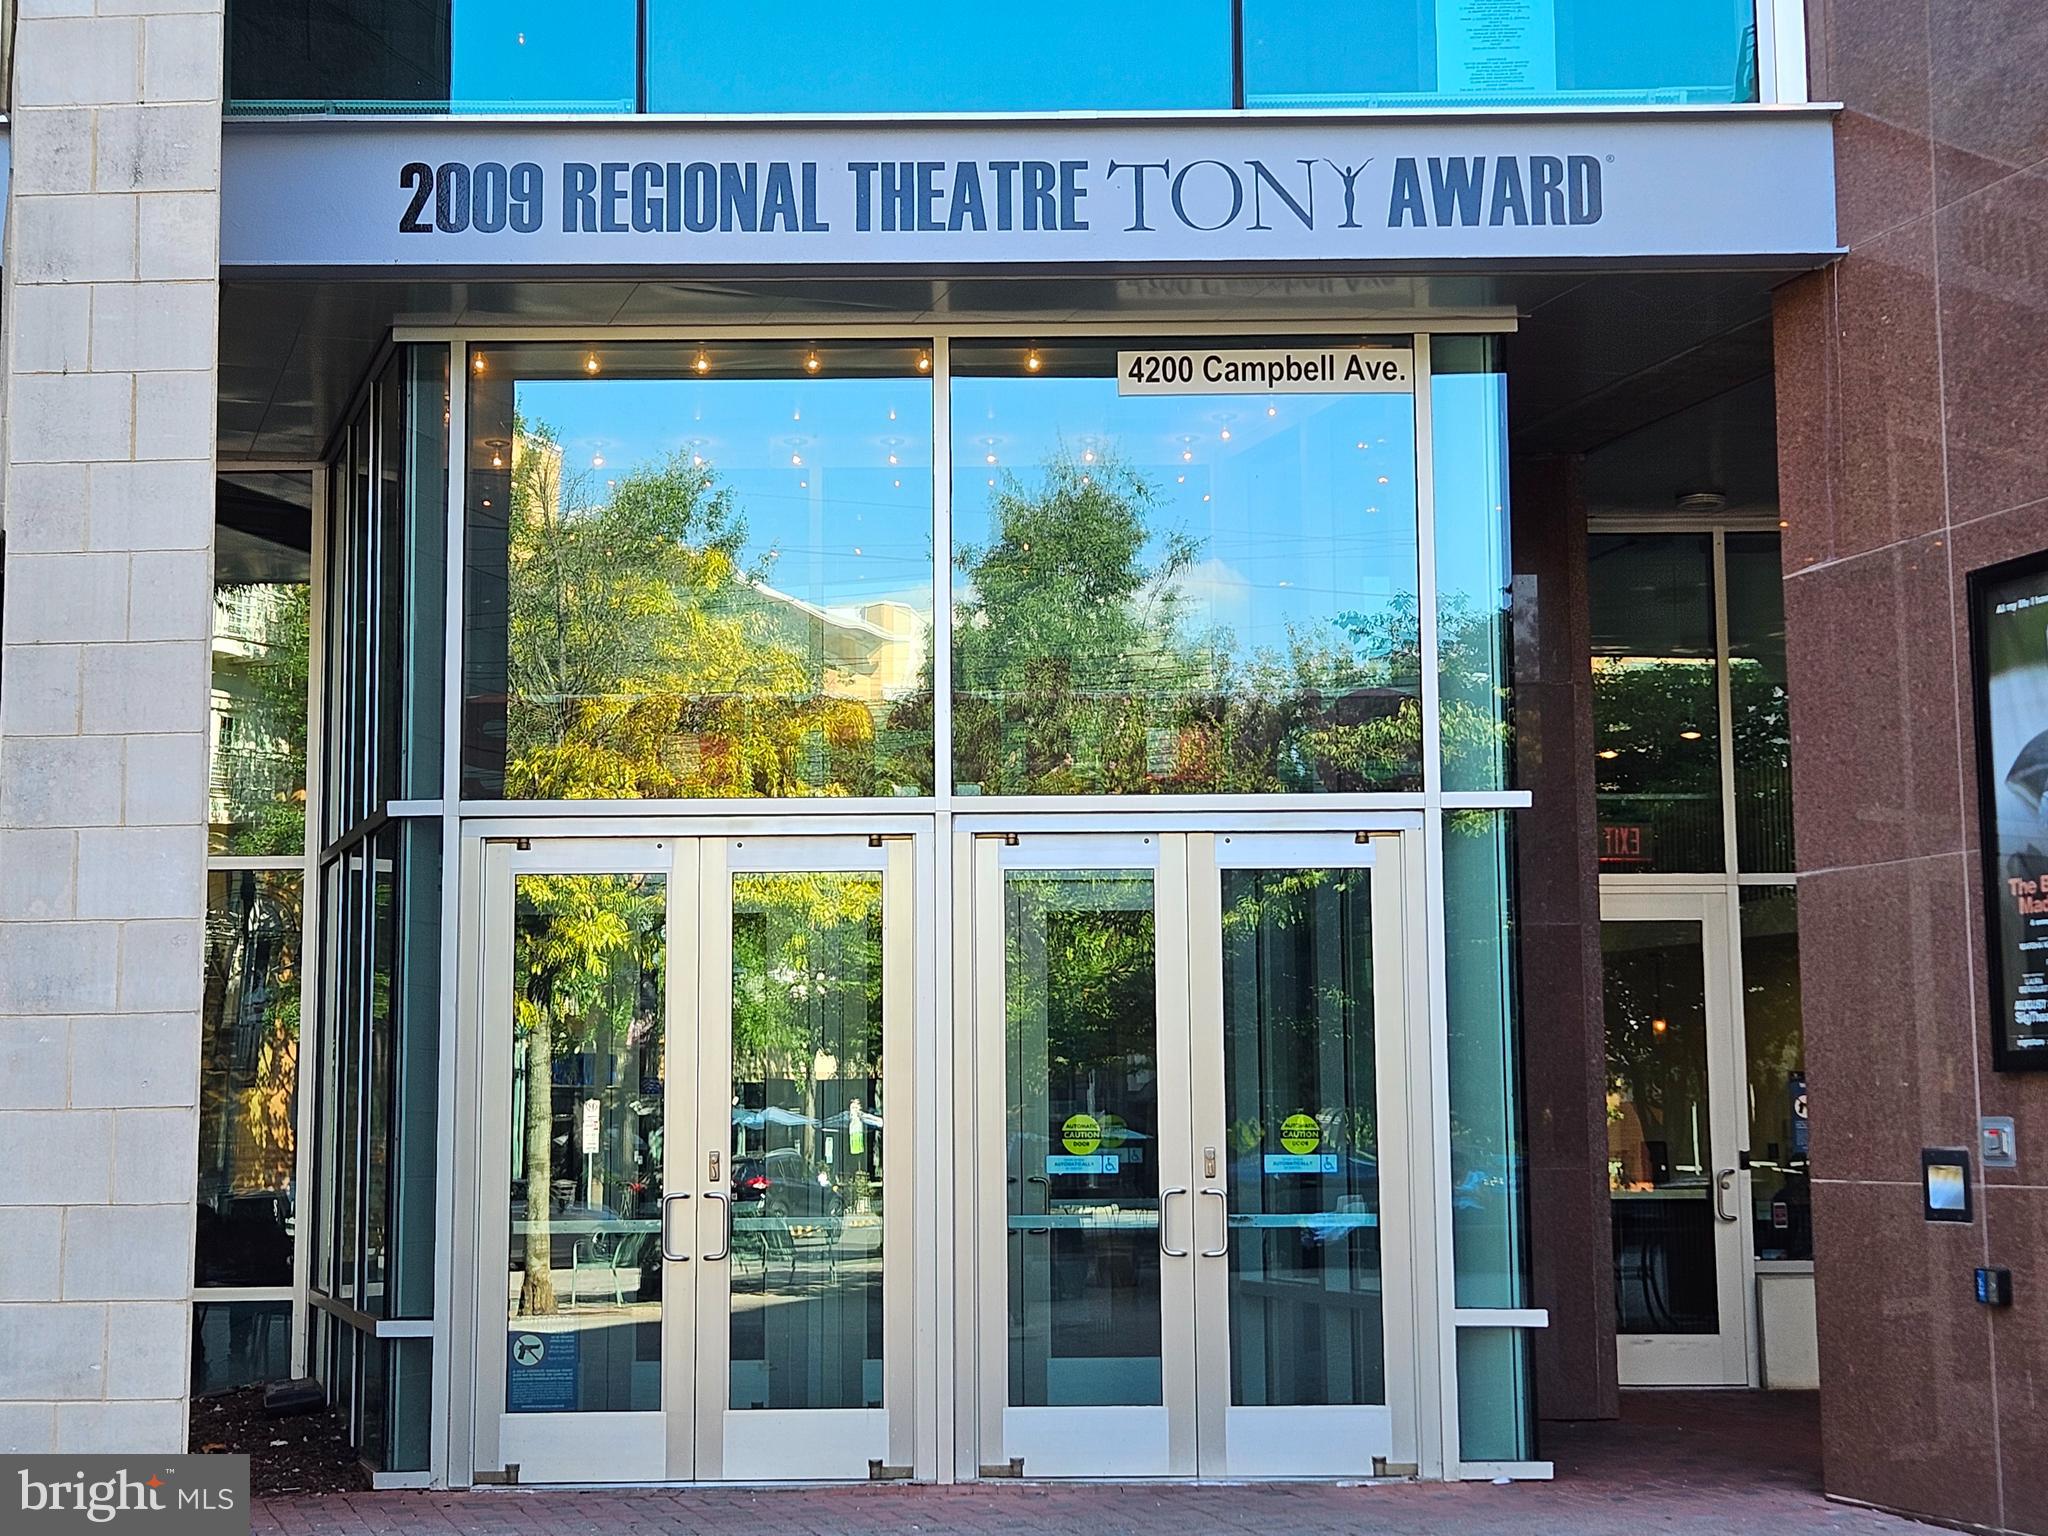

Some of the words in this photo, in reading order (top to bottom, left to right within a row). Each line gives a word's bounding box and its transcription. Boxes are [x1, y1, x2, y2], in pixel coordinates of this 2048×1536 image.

[399, 162, 544, 233] 2009
[562, 162, 830, 233] REGIONAL
[848, 161, 1090, 232] THEATRE
[1106, 157, 1374, 232] TONY
[1128, 355, 1194, 383] 4200
[1202, 354, 1335, 388] Campbell
[1343, 354, 1406, 382] Ave.
[2008, 877, 2037, 896] The
[1063, 1131, 1100, 1139] CAUTION
[1282, 1130, 1319, 1138] CAUTION
